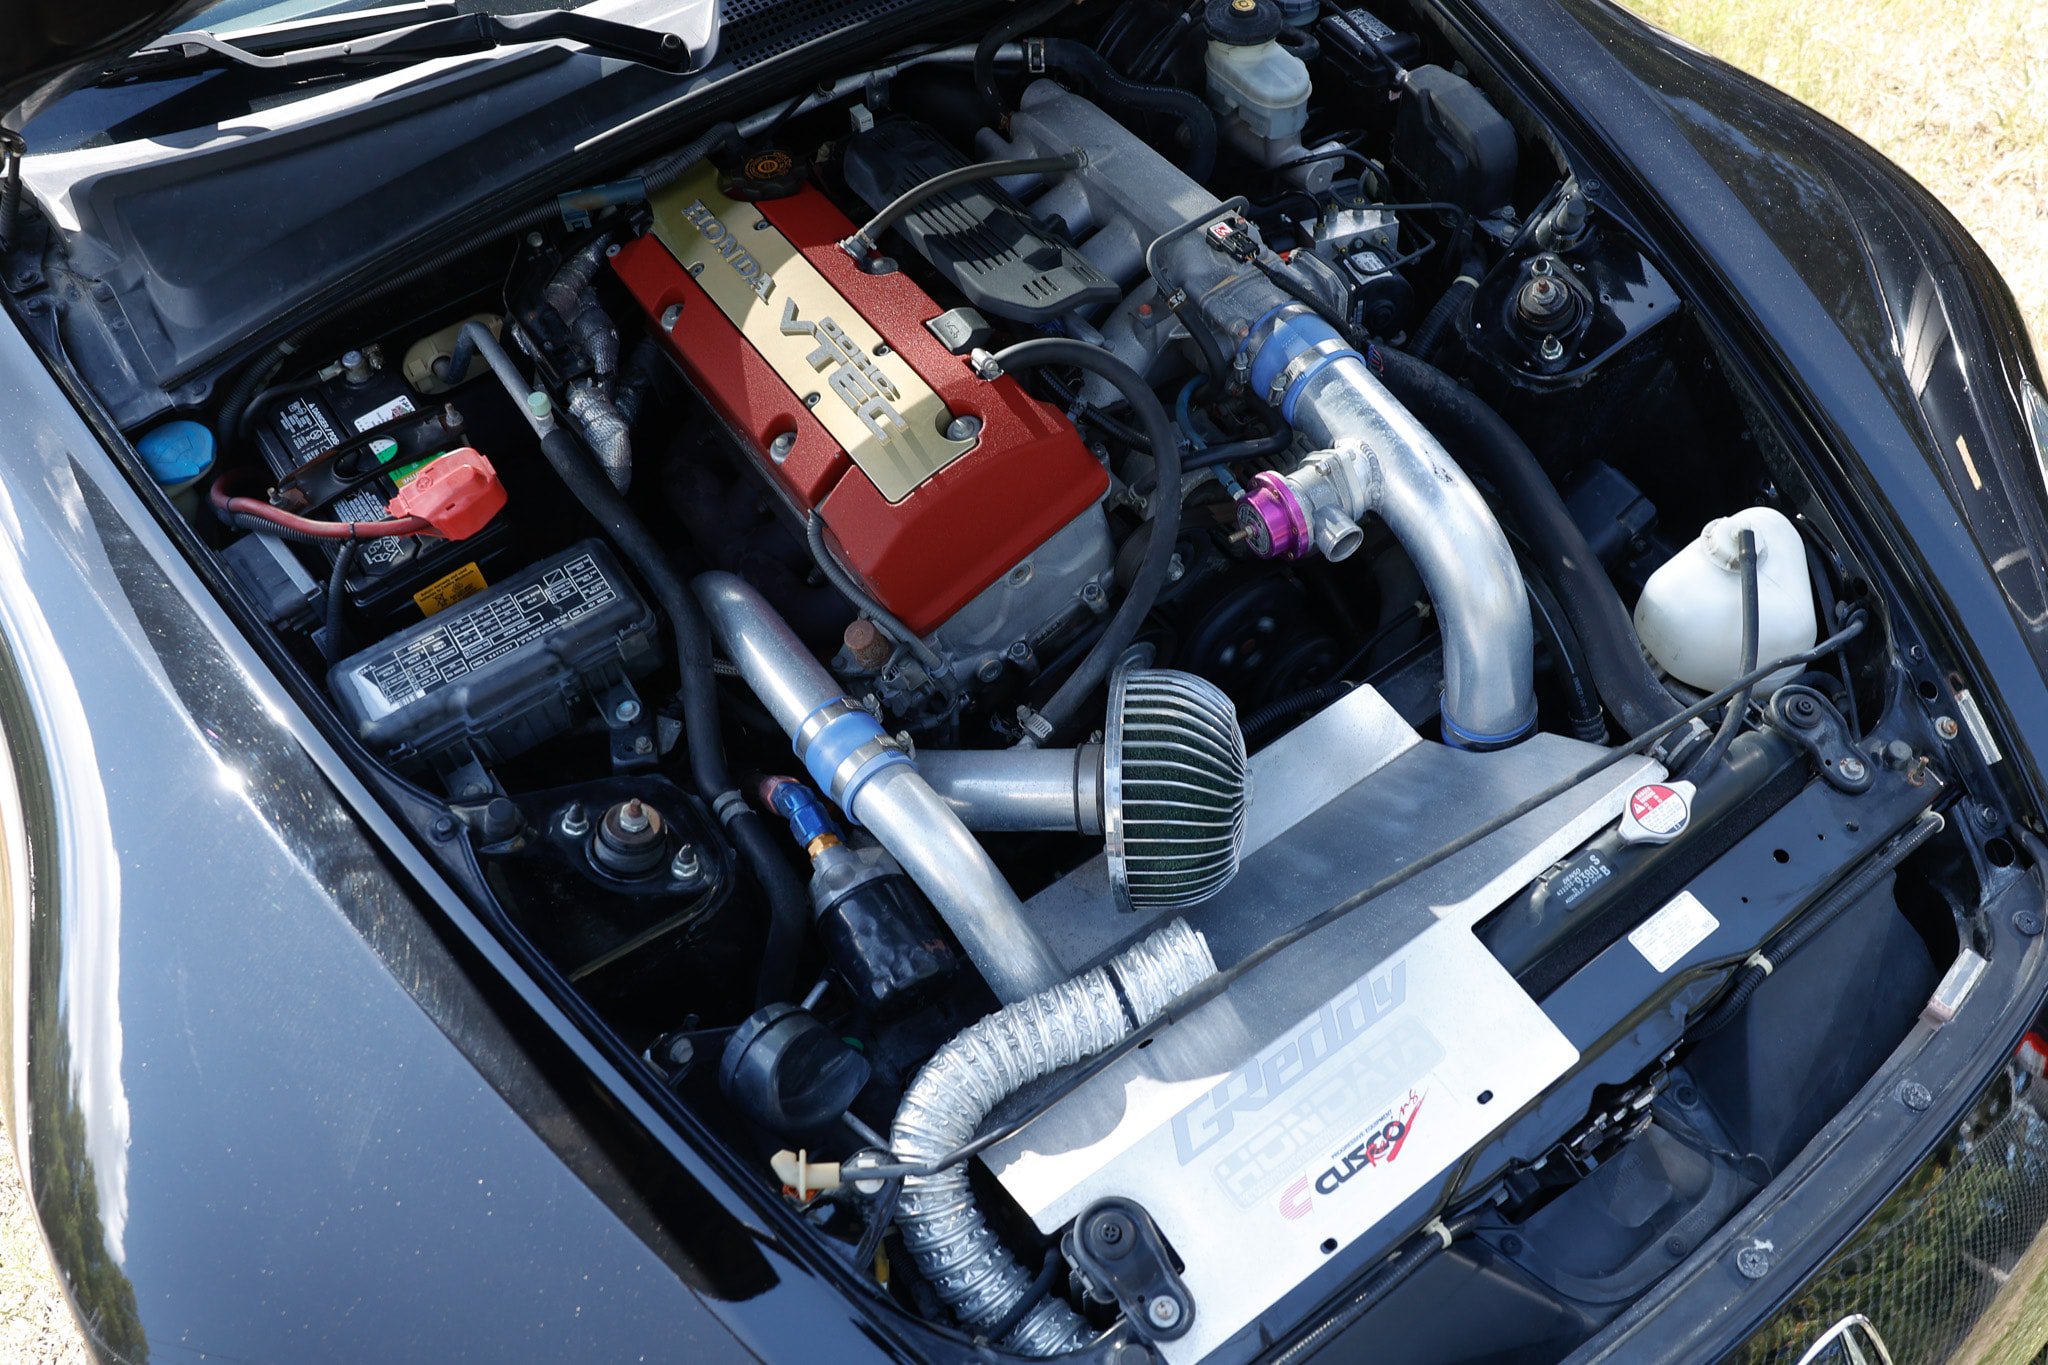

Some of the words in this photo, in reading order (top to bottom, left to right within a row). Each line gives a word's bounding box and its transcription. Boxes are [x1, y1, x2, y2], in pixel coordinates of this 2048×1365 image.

[682, 199, 776, 305] HONDA
[818, 317, 901, 402] DOHC
[780, 296, 909, 443] VTEC
[502, 627, 516, 636] SPARE
[516, 620, 530, 629] FUSES
[406, 640, 421, 651] SPARE
[421, 634, 434, 644] FUSES
[487, 643, 513, 659] BATTERY
[419, 668, 431, 678] STOP
[1589, 853, 1600, 866] S
[1561, 867, 1581, 884] DENSO
[1598, 863, 1611, 877] B
[1213, 1016, 1434, 1197] HONDATA
[1315, 1119, 1405, 1195] CUSCO
